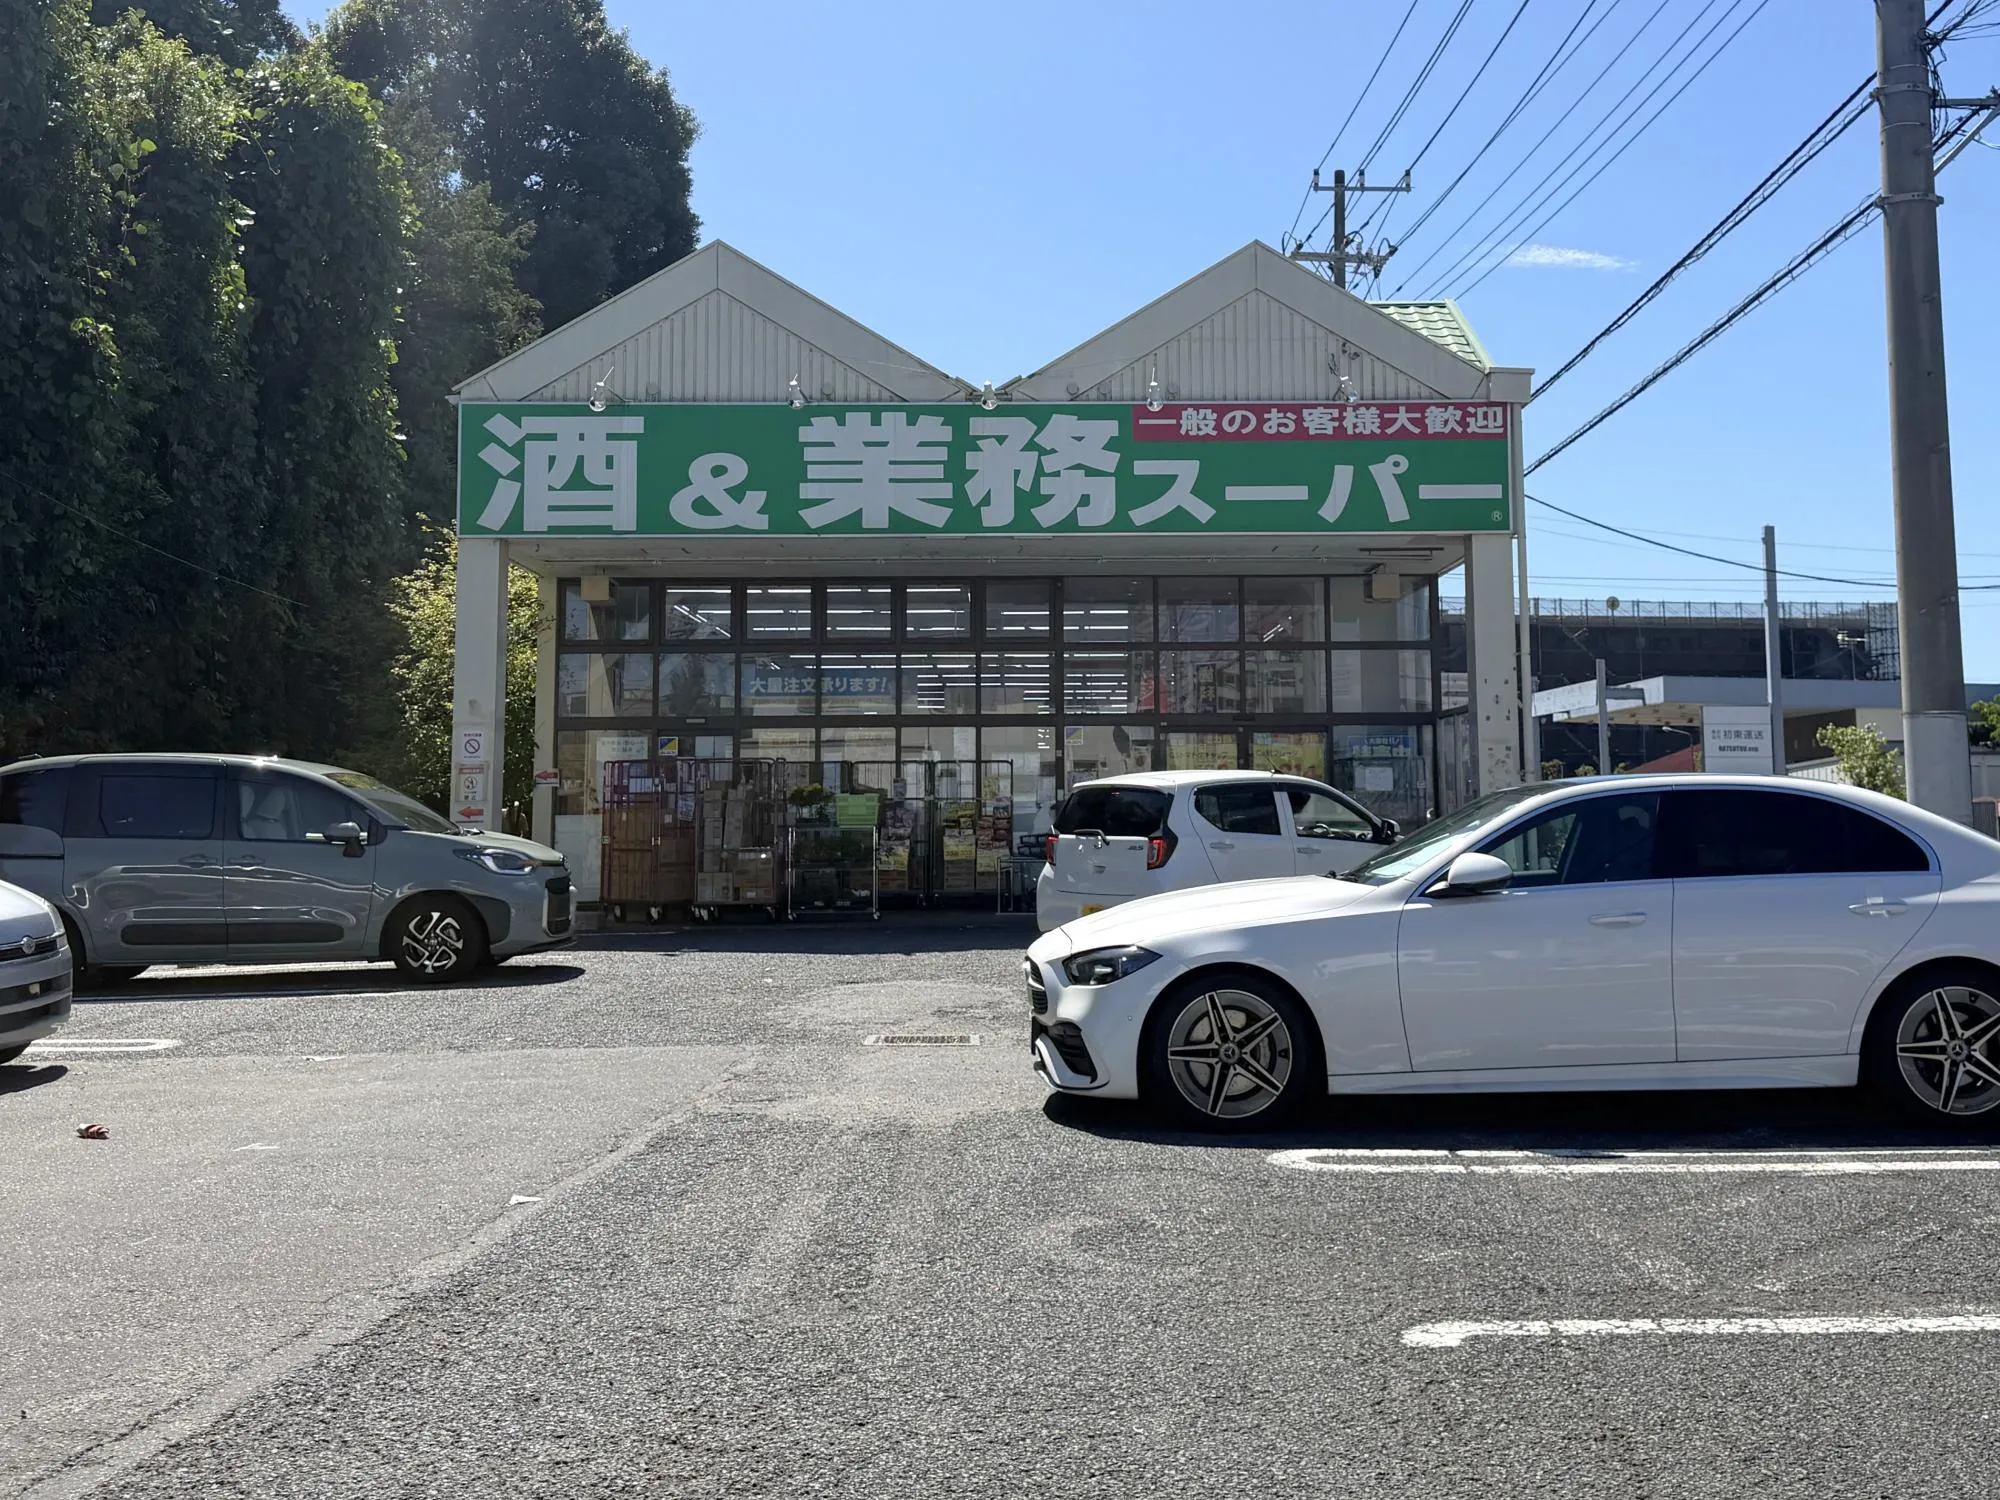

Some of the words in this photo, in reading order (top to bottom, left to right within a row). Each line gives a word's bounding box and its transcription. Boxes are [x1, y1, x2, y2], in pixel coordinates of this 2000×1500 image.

[1138, 405, 1505, 437] 一般のお客様大歓迎
